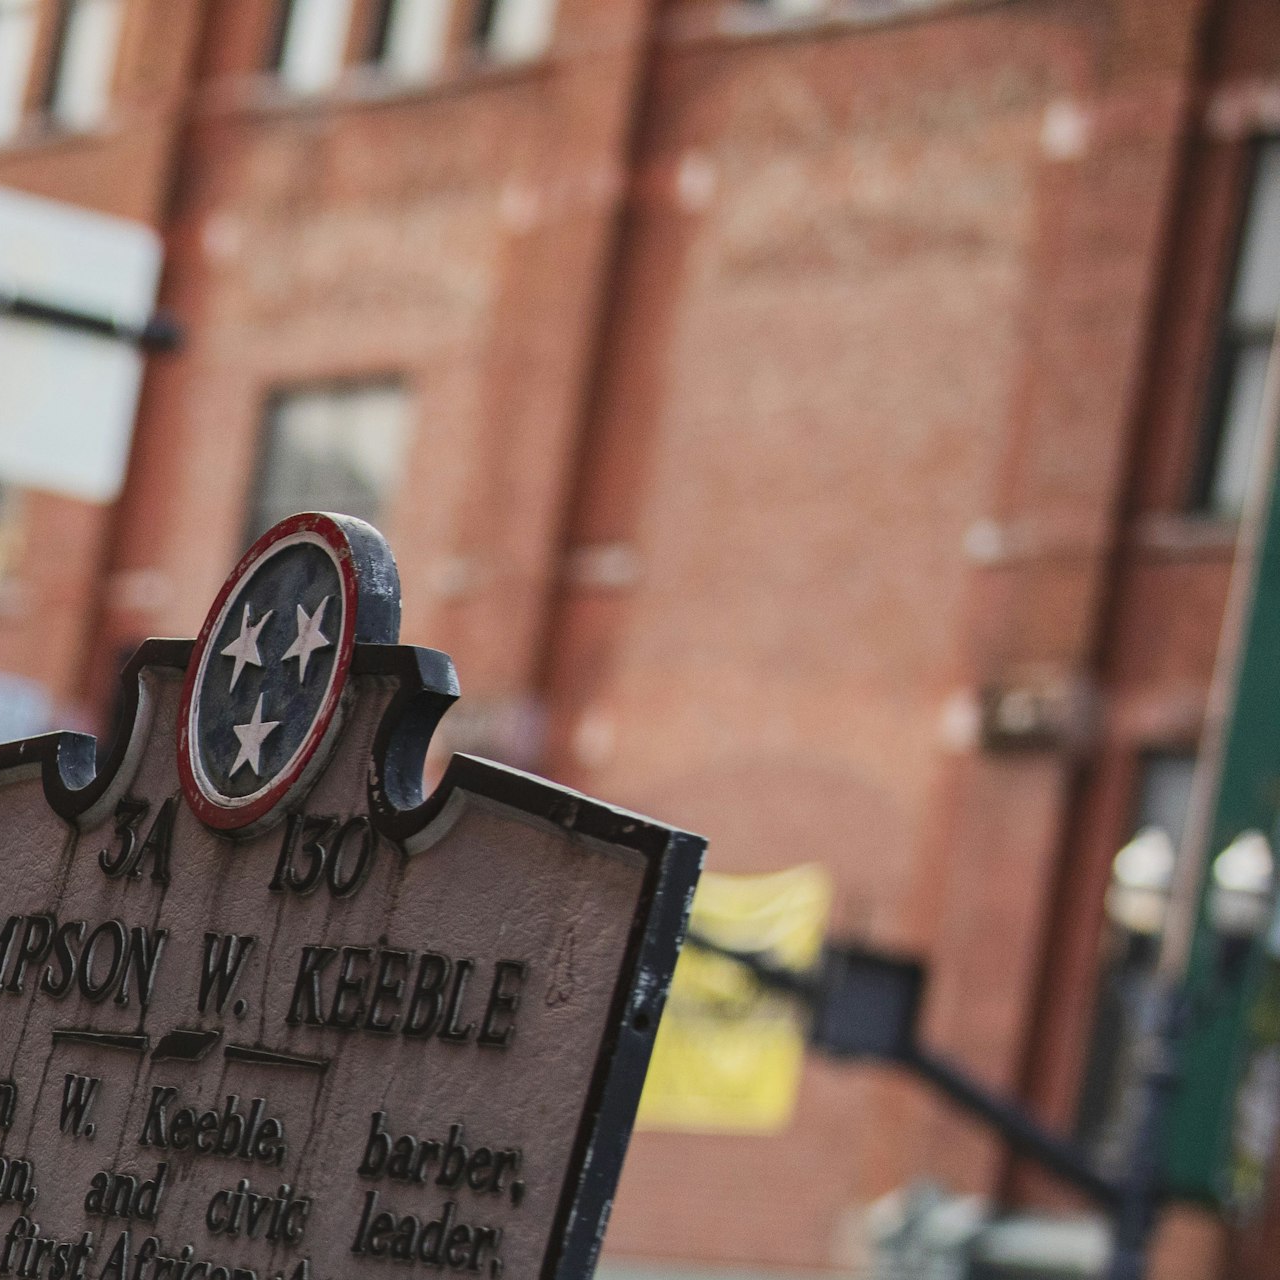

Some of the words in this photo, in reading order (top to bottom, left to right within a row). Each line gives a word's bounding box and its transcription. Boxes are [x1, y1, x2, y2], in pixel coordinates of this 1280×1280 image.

[98, 792, 180, 883] 3A
[268, 811, 377, 898] 130
[197, 930, 258, 1022] W.
[285, 945, 528, 1049] KEEBLE
[59, 1072, 103, 1138] W.
[141, 1084, 288, 1167] Keeble,
[357, 1110, 526, 1205] barber,
[83, 1161, 169, 1221] and
[205, 1178, 312, 1245] civic
[350, 1189, 503, 1279] leader,
